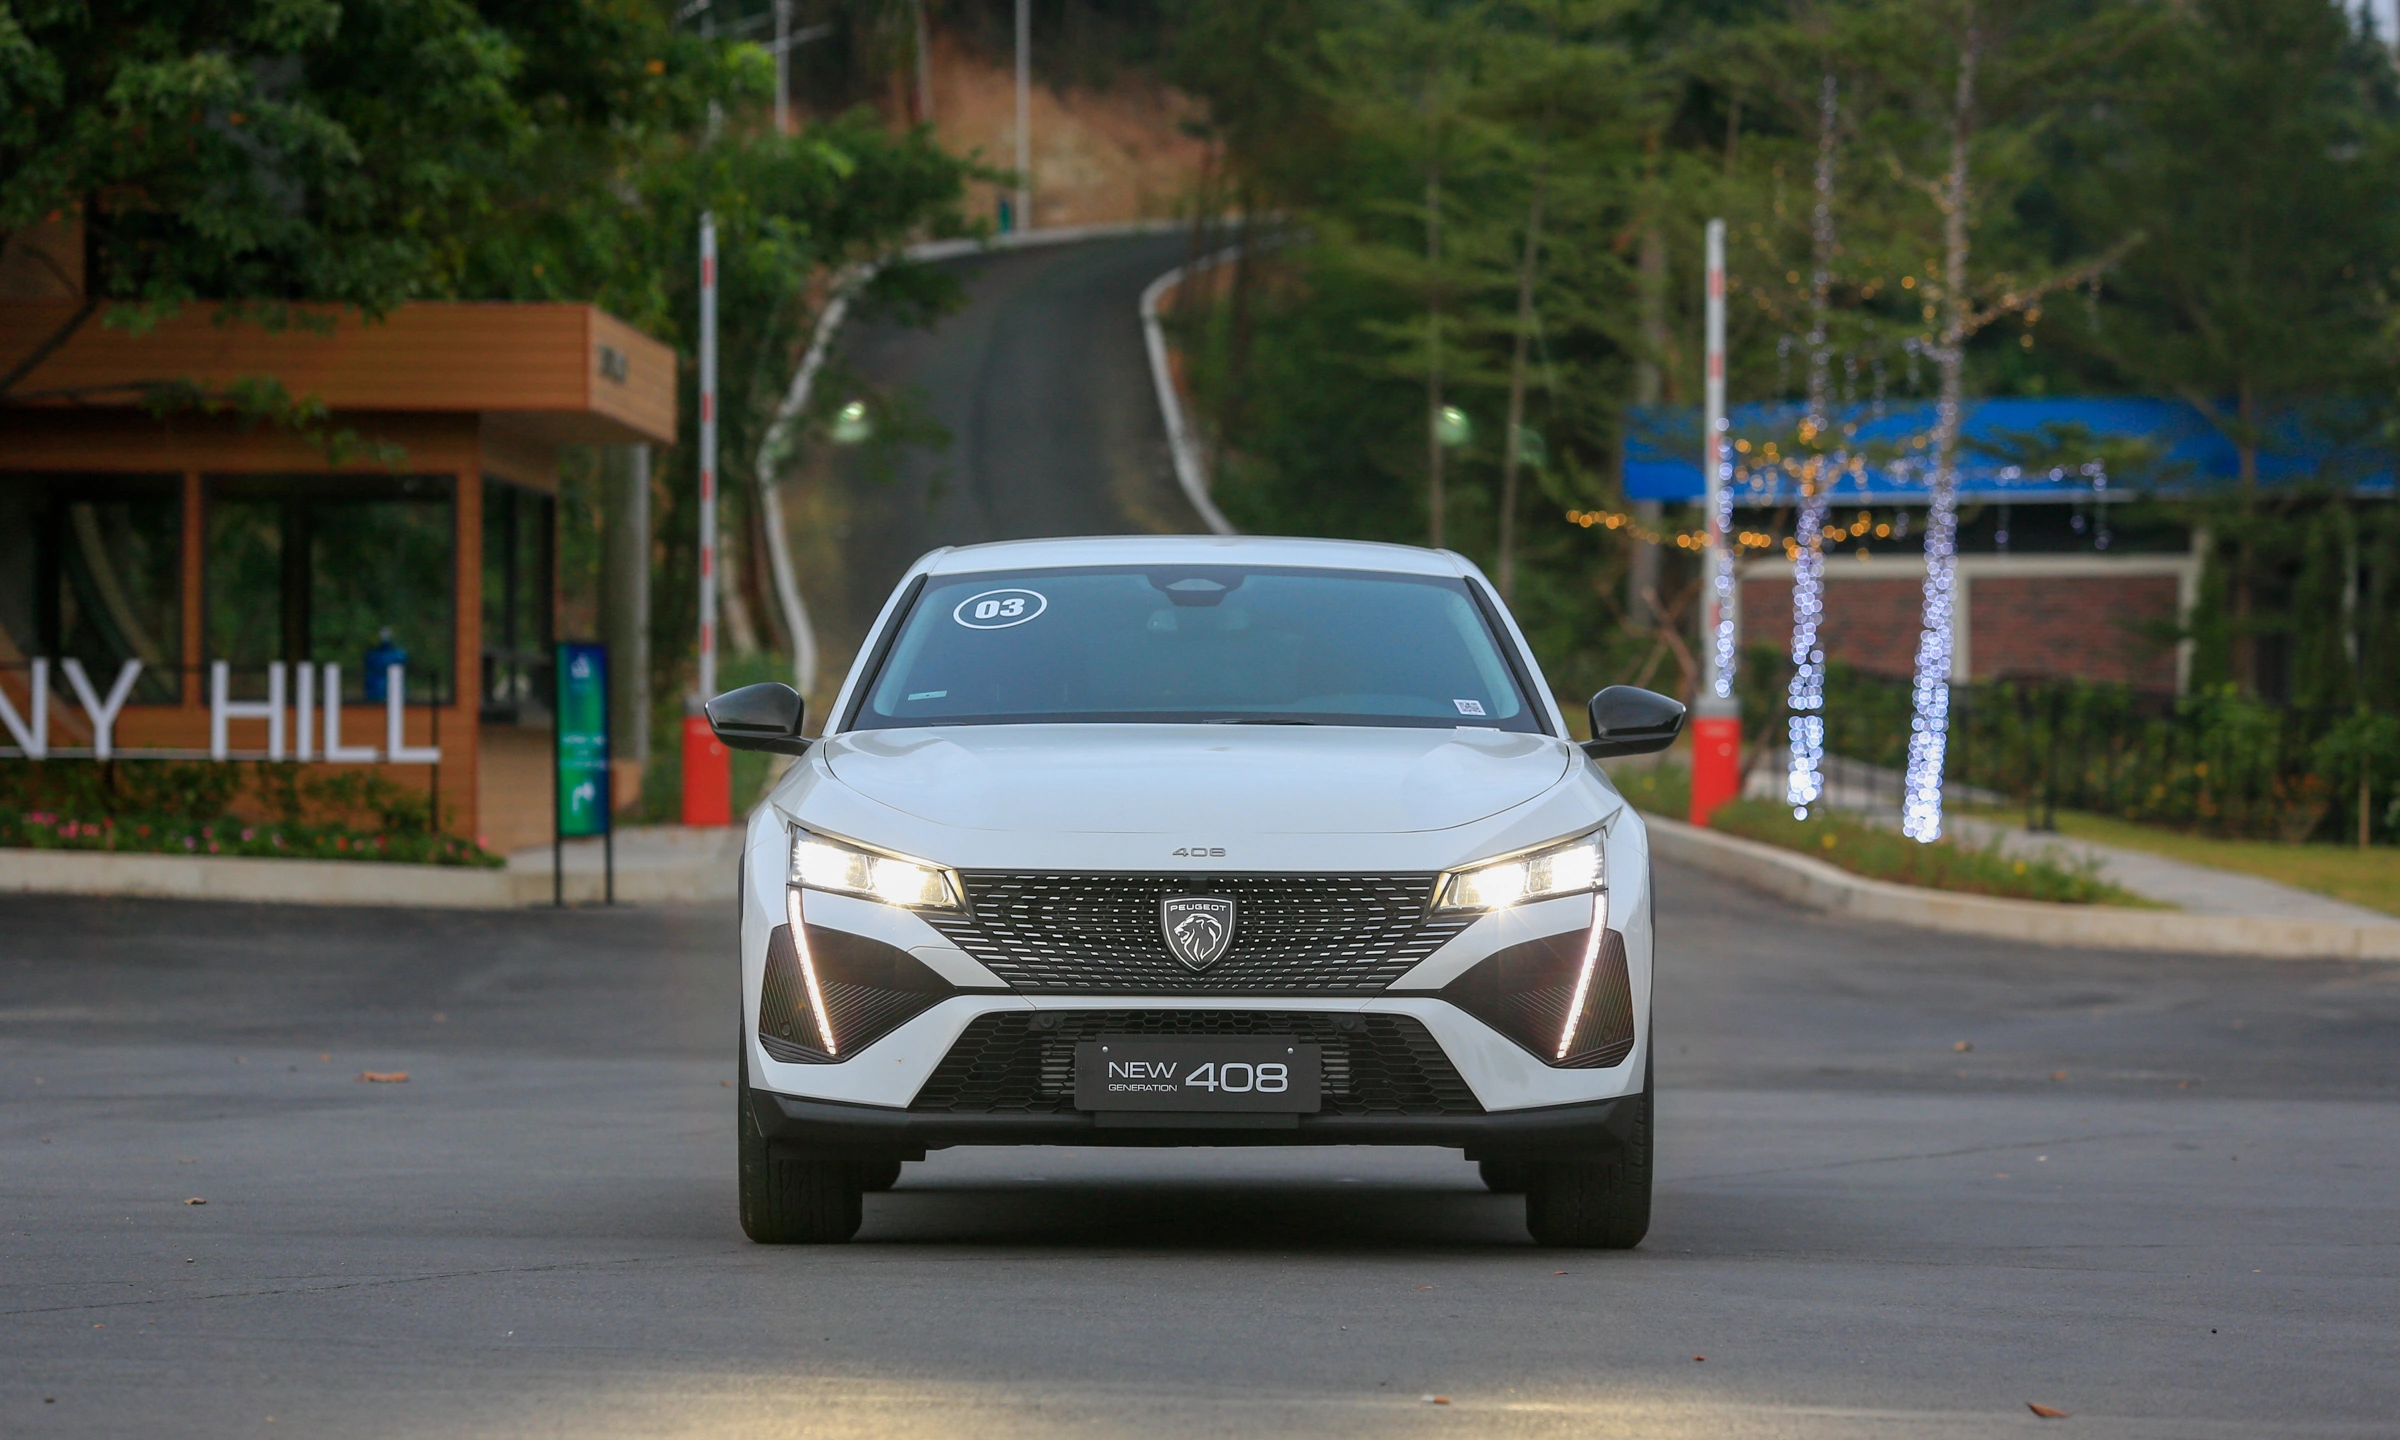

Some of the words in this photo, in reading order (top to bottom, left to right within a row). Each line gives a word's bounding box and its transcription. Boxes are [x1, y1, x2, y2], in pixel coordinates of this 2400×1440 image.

[974, 598, 1025, 619] 03
[210, 660, 441, 763] HILL
[1172, 847, 1226, 857] 408
[1170, 903, 1227, 911] PEUGEOT
[1108, 1061, 1178, 1079] NEW
[1185, 1062, 1289, 1093] 408
[1108, 1083, 1178, 1092] GENERATION
